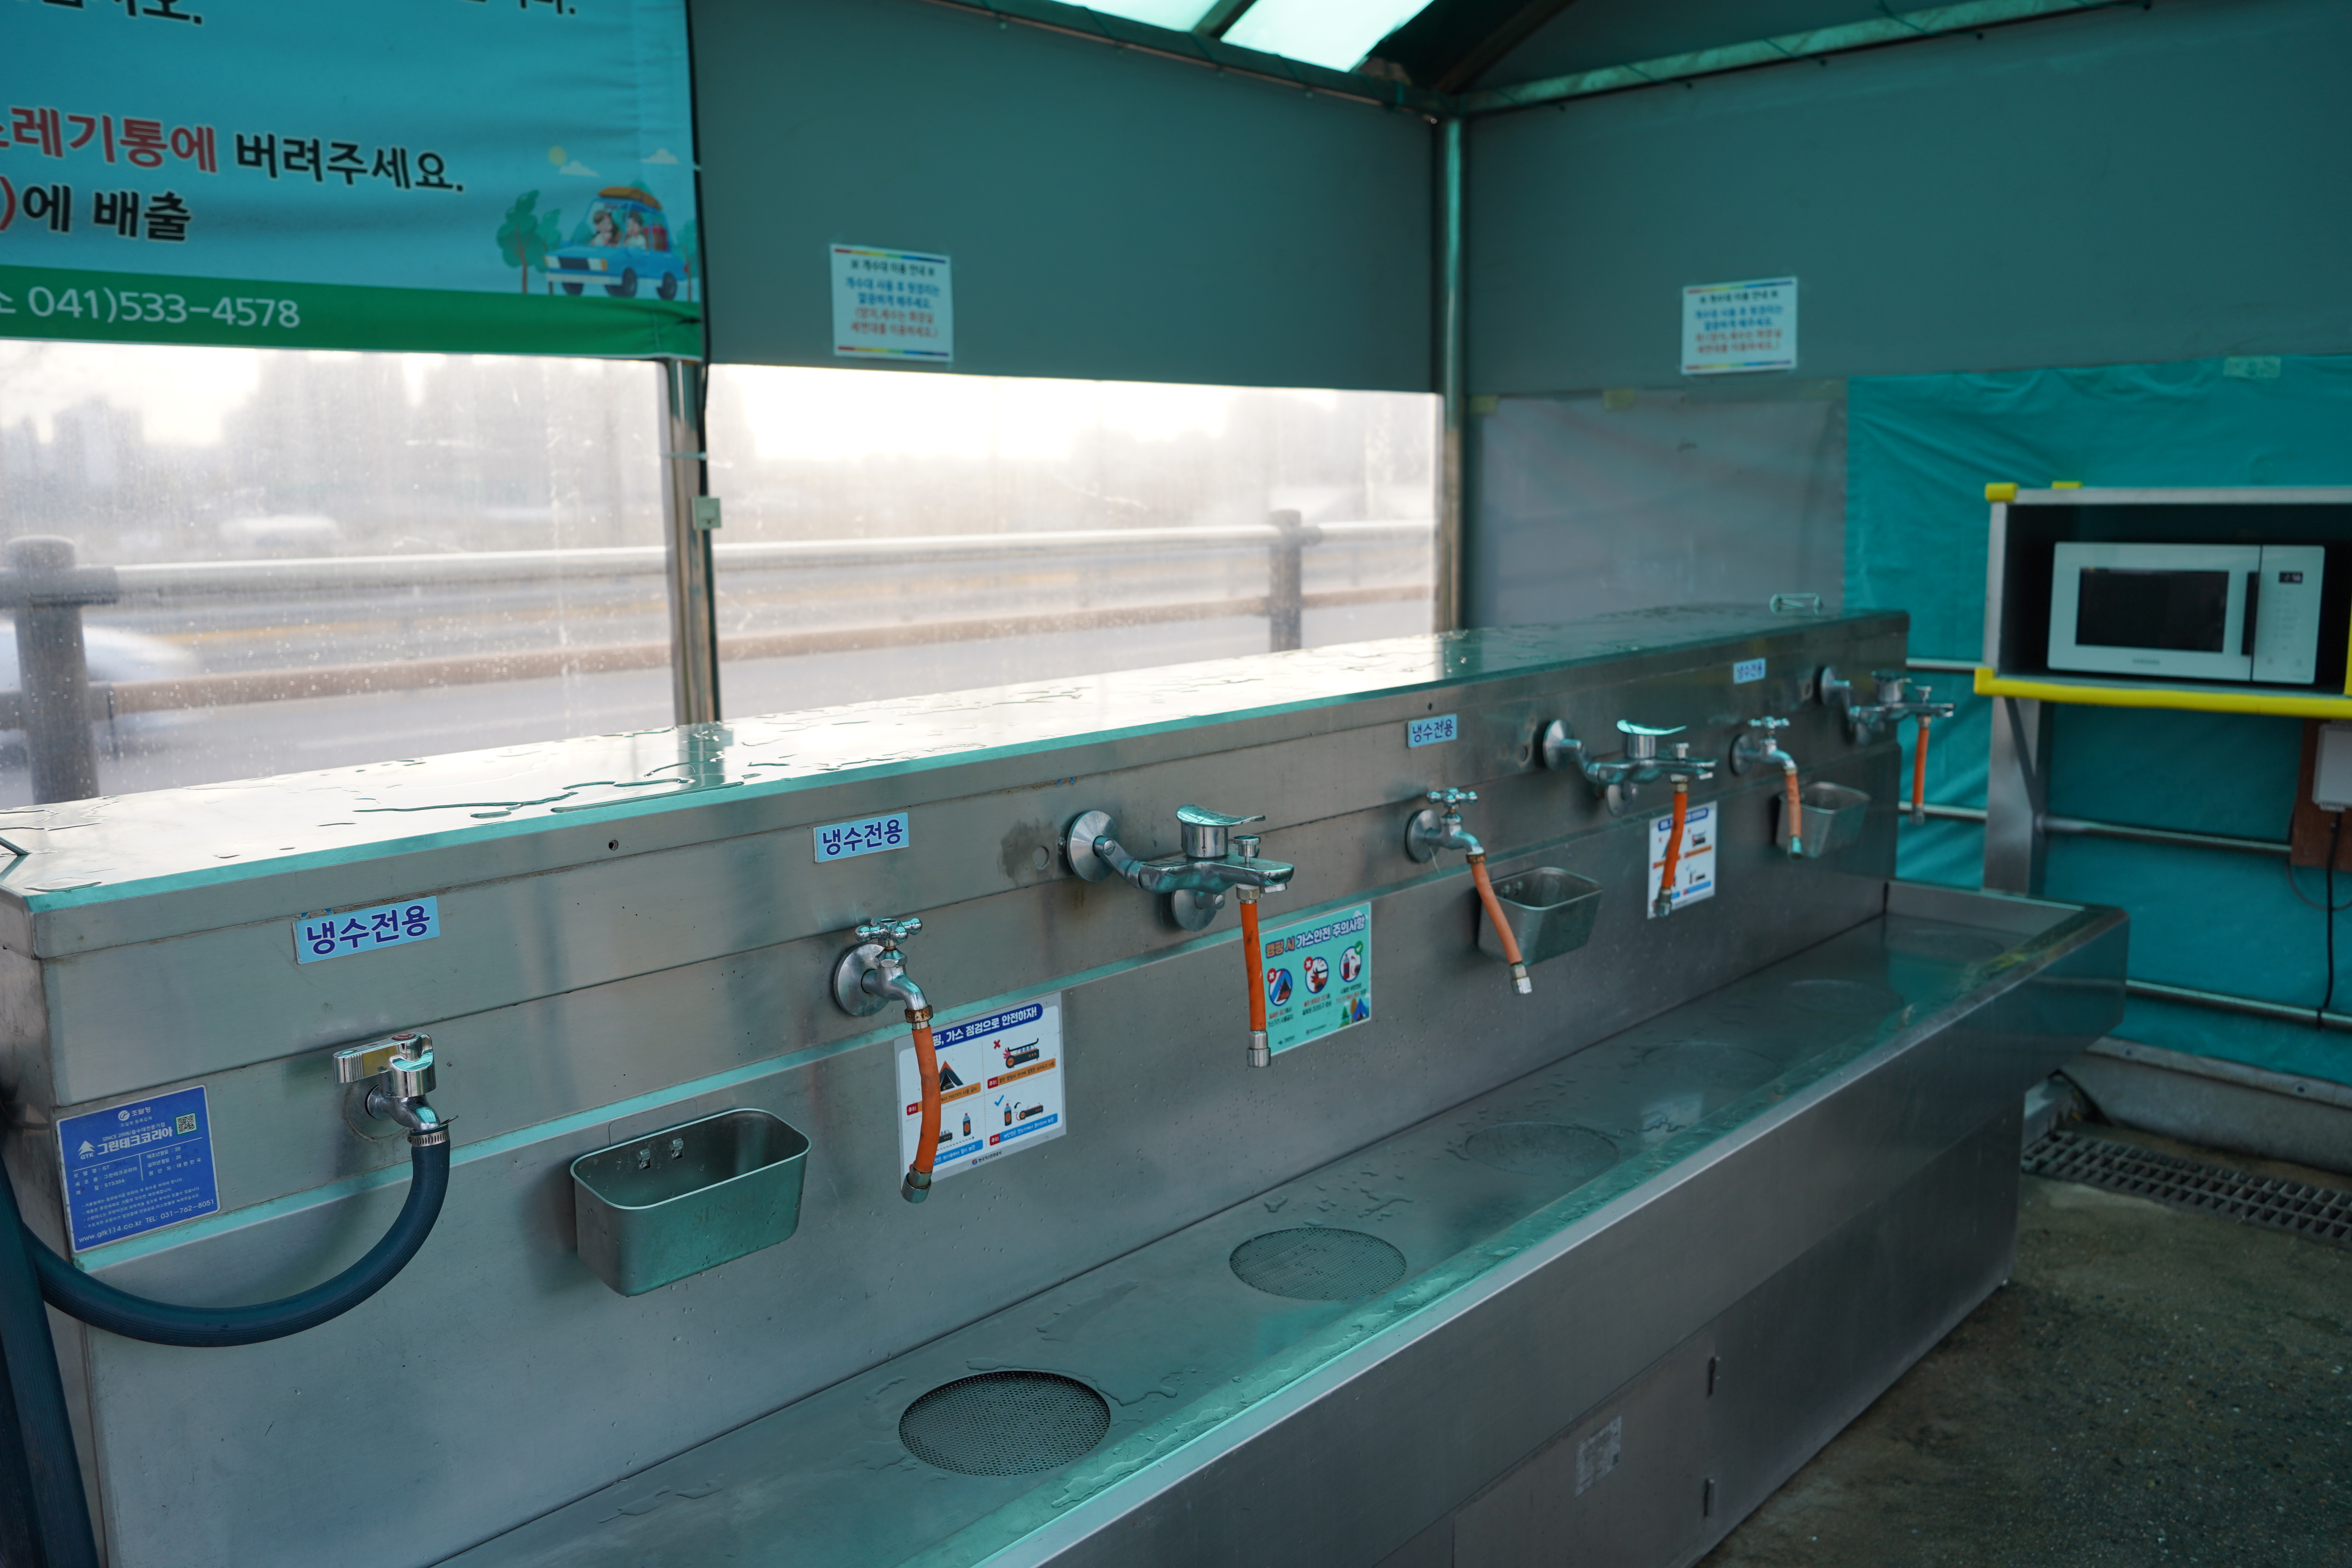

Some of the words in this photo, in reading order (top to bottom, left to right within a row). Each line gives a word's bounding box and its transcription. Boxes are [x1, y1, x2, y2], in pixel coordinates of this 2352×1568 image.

[0, 107, 217, 172] 레기통에
[236, 132, 465, 192] 버려주세요.
[93, 191, 191, 241] 배출
[28, 285, 300, 329] 041)533-4578
[1413, 719, 1453, 742] 냉수전용
[823, 819, 903, 855] 냉수전용
[307, 905, 430, 955] 냉수전용
[1265, 939, 1283, 958] 캠핑
[1285, 937, 1295, 952] 시
[1297, 926, 1330, 949] 가스안전
[1332, 915, 1365, 937] 주의사항
[933, 1033, 944, 1048] 핑,
[946, 1027, 964, 1044] 가스
[965, 1016, 1000, 1038] 점검으로
[1002, 1005, 1037, 1027] 안전하자!
[132, 1107, 151, 1116] 조달청
[98, 1127, 173, 1155] 그린테크코리아
[104, 1167, 137, 1178] 그린테크코리아
[105, 1179, 125, 1187] STS304
[161, 1199, 214, 1219] 031-762-8051
[79, 1221, 142, 1242] www.gtk114.co.kr
